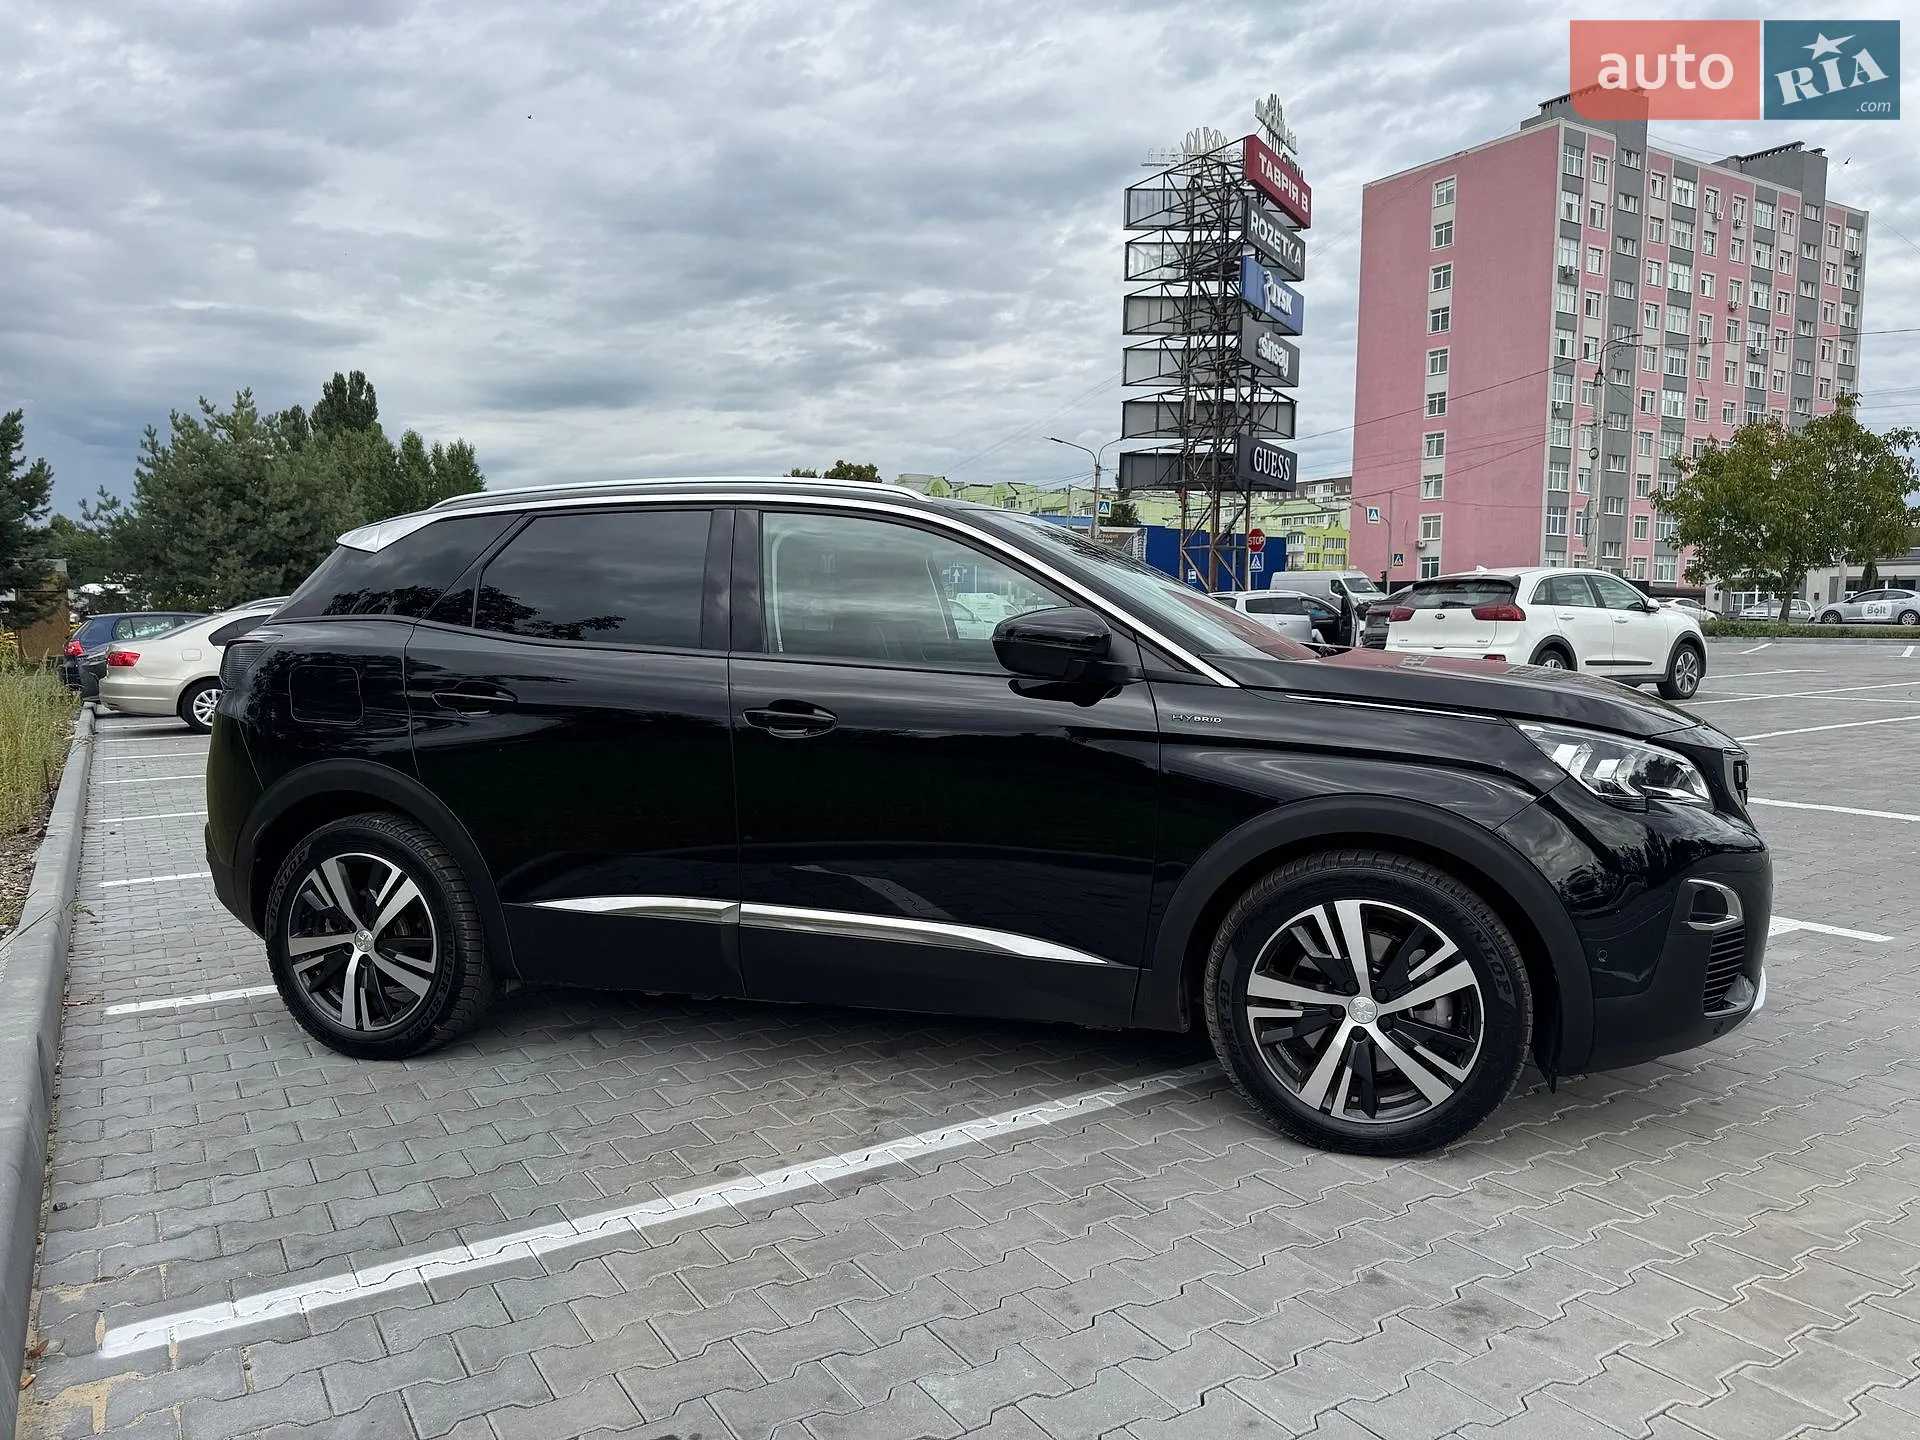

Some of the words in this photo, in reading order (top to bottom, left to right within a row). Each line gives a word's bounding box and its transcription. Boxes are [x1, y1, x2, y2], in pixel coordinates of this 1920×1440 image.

[1258, 152, 1299, 205] ТАВРІЯ
[1301, 192, 1309, 213] В
[1250, 209, 1302, 267] ROZETKA
[1270, 284, 1293, 315] JYSK
[1257, 331, 1289, 378] sinsay
[1253, 445, 1291, 482] GUESS
[1248, 536, 1264, 546] STOP
[1867, 606, 1887, 614] Bolt
[1172, 714, 1222, 723] HYBRID
